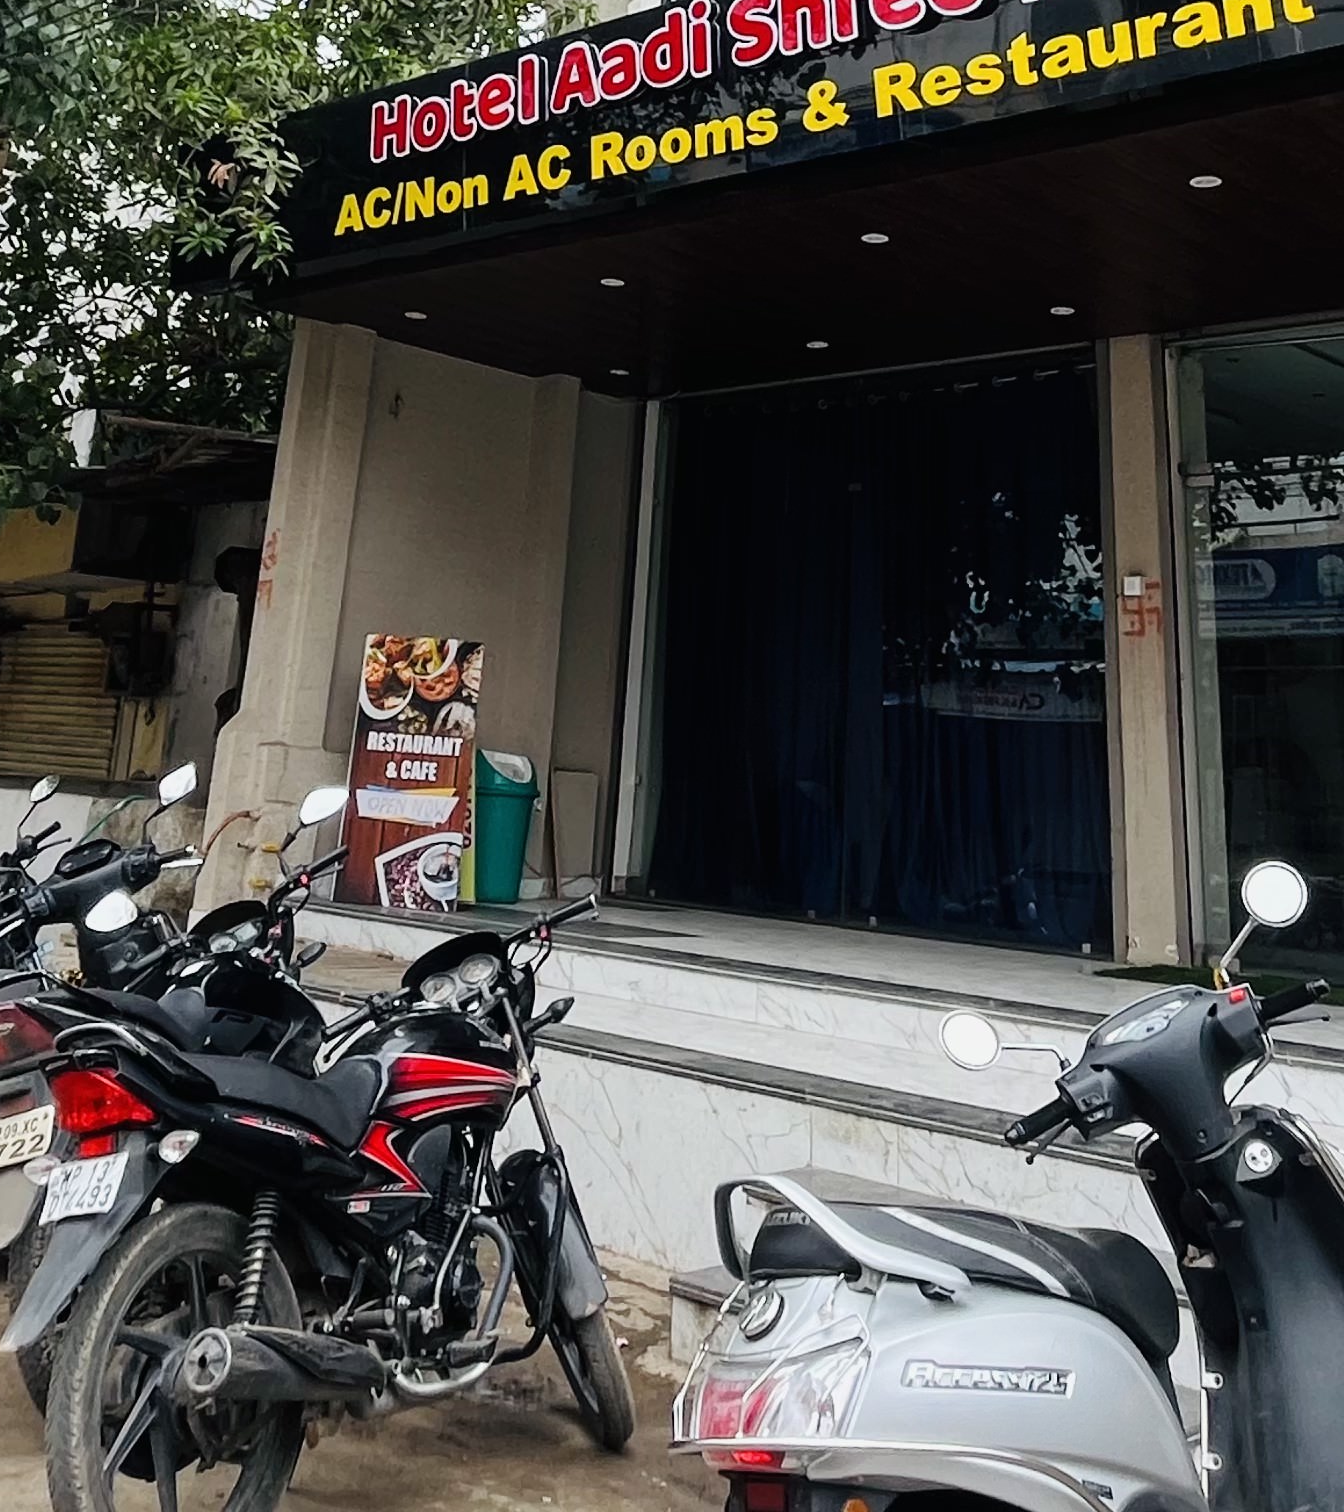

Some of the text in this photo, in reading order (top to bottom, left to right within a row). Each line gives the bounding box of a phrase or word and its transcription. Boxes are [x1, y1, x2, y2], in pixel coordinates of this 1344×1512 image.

[369, 53, 540, 164] Hotel
[333, 173, 488, 237] AC/Non
[502, 144, 571, 202] AC
[590, 106, 779, 181] Rooms
[801, 78, 851, 134] &
[366, 731, 464, 757] RESTAURANT
[384, 760, 439, 782] & CAFE
